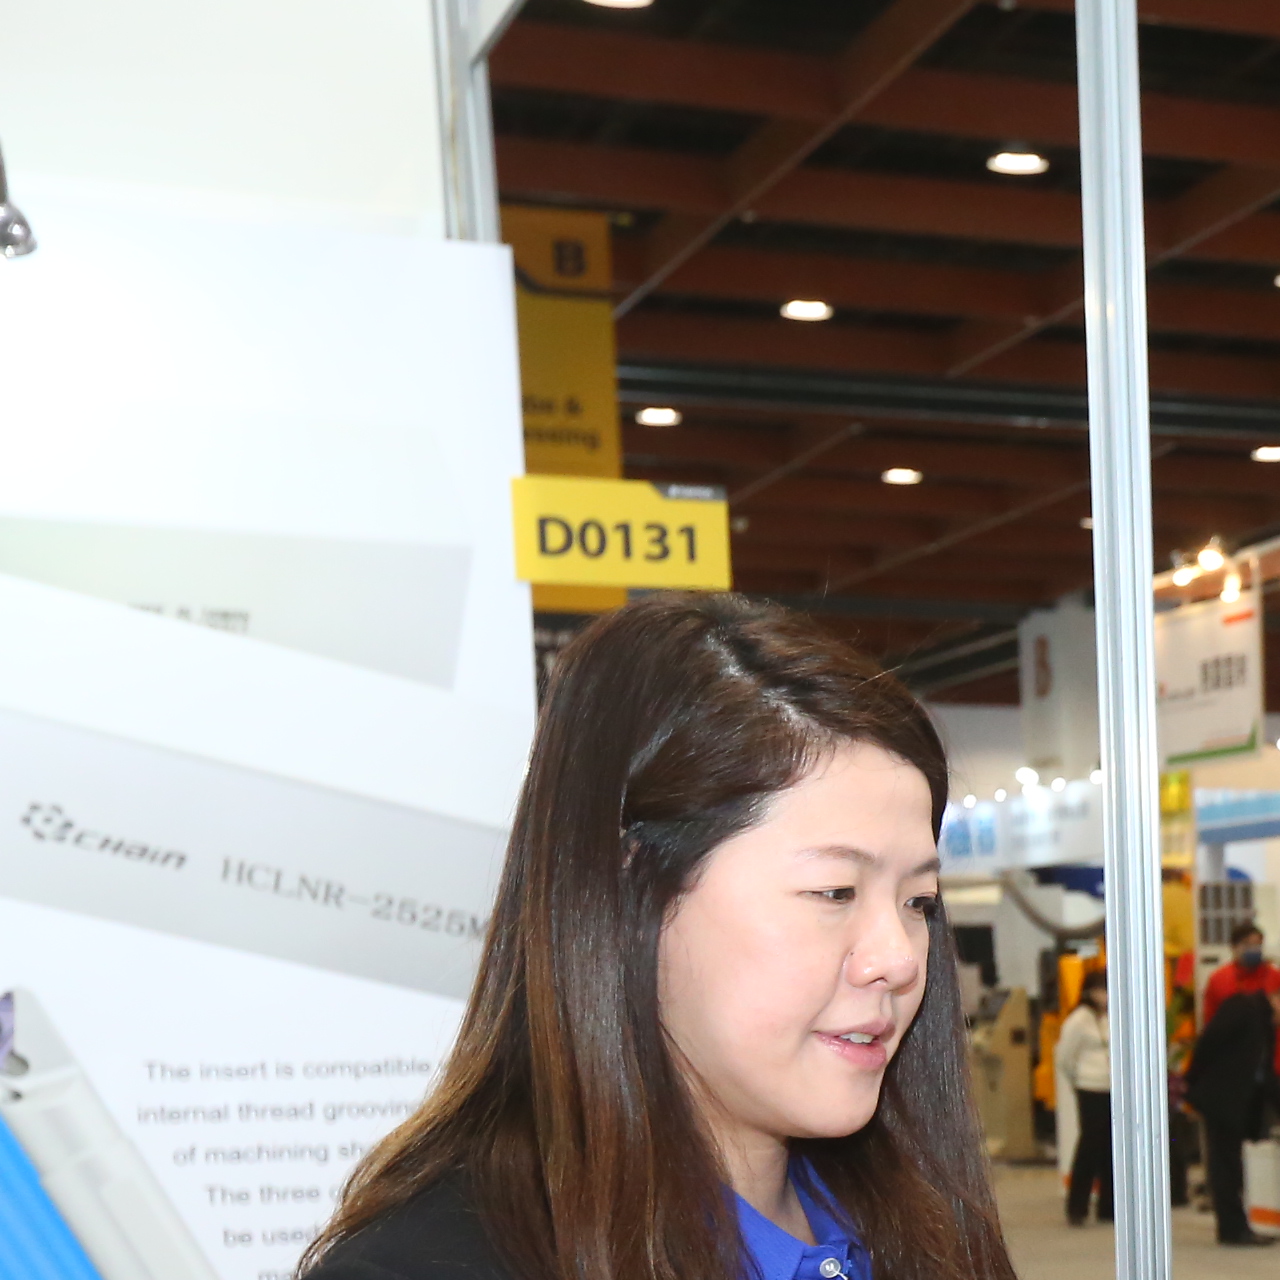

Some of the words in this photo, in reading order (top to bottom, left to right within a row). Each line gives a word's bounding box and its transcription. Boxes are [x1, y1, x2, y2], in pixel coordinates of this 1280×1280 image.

[537, 515, 699, 565] D0131
[147, 1061, 190, 1081] The
[199, 1061, 268, 1079] insert
[275, 1061, 294, 1078] is
[302, 1058, 430, 1082] compatible
[137, 1104, 230, 1124] internal
[238, 1102, 315, 1122] thread
[322, 1099, 417, 1125] groovin
[173, 1144, 195, 1166] of
[204, 1142, 330, 1167] machining
[206, 1185, 250, 1204] The
[259, 1184, 320, 1202] three
[223, 1229, 252, 1246] be
